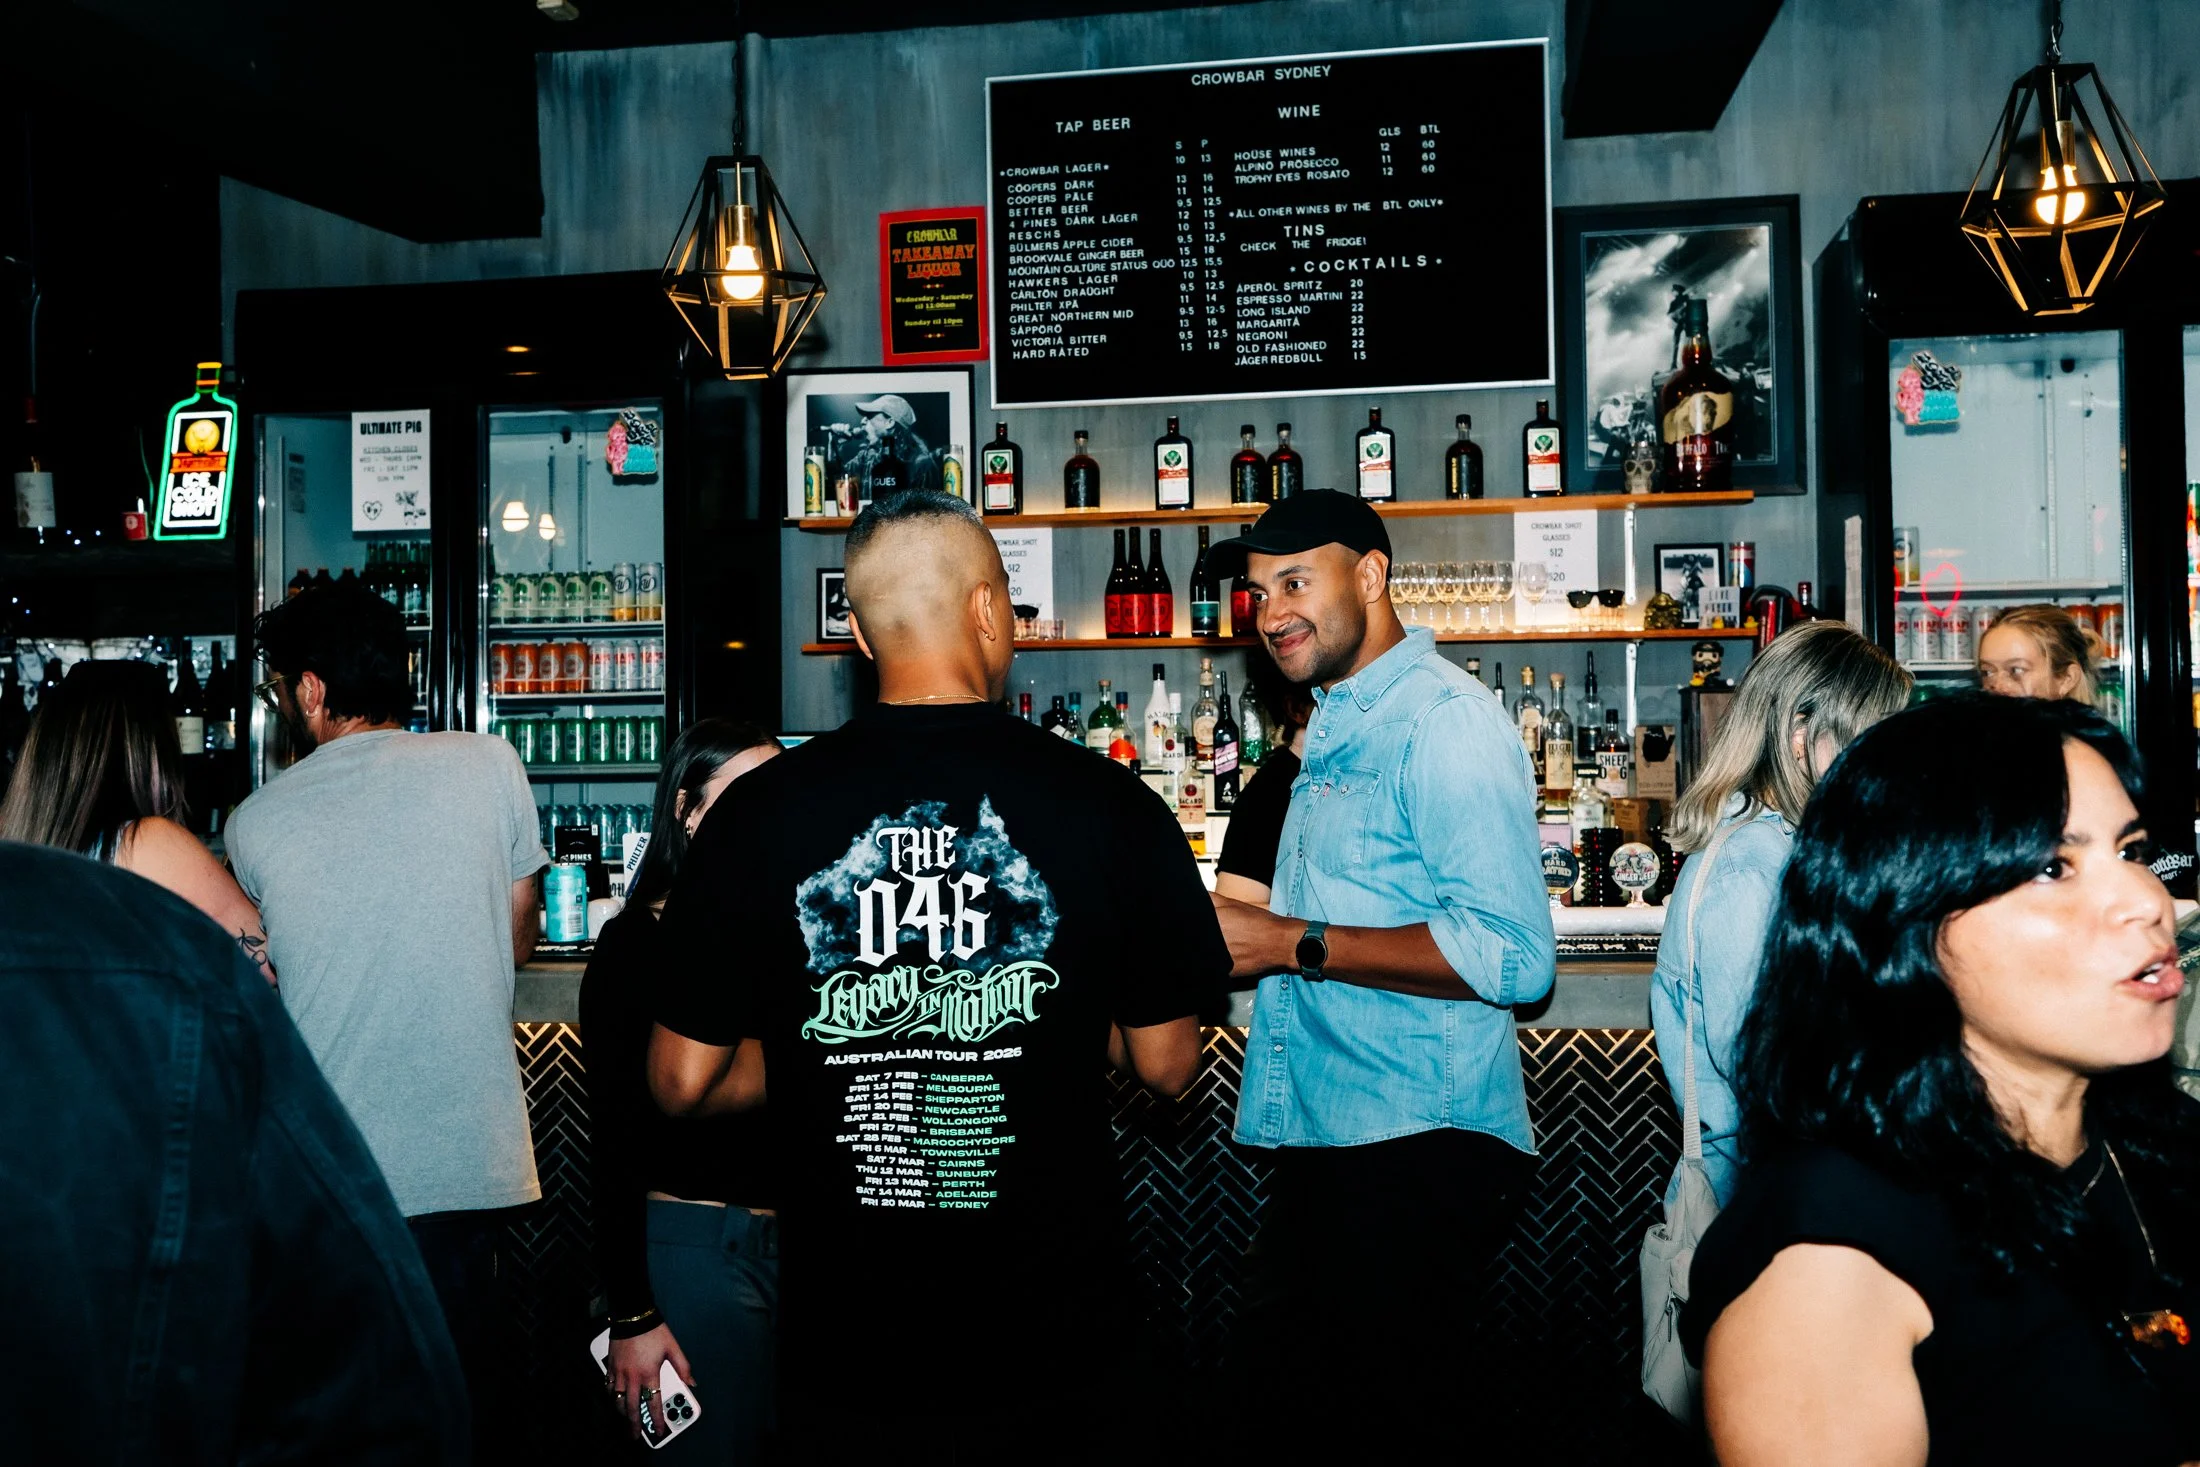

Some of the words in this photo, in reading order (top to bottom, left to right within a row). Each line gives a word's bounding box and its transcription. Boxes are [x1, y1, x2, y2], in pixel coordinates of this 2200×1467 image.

[1191, 70, 1264, 85] CROWBAR
[1275, 65, 1331, 80] SYDNEY
[1278, 105, 1320, 118] WINE
[1056, 121, 1083, 133] TAP
[1093, 118, 1130, 131] BEER
[1379, 127, 1401, 136] GLS
[1420, 124, 1440, 134] BTL
[1279, 147, 1316, 157] WINES
[1006, 165, 1059, 177] CROWBAR
[1066, 163, 1101, 173] LAGER
[1235, 174, 1272, 184] TROPHY
[1276, 172, 1300, 182] EYES
[1307, 169, 1350, 180] ROSATO
[1421, 164, 1435, 173] 60
[1009, 206, 1052, 217] BETTER
[1061, 204, 1088, 214] BEER
[1258, 207, 1292, 217] OTHER
[1296, 205, 1330, 214] WINES
[1335, 204, 1347, 213] BY
[1353, 202, 1371, 211] THE
[1383, 200, 1402, 210] BTL
[1408, 199, 1436, 208] ONLY
[1023, 218, 1057, 227] PINES
[1009, 230, 1061, 240] RESCHS
[1284, 224, 1324, 237] TINS
[1101, 238, 1133, 248] CIDER
[1240, 242, 1276, 252] CHECK
[1292, 240, 1310, 248] THE
[892, 244, 976, 263] TAKEAWAY
[1010, 253, 1072, 264] BROOKVALE
[1078, 250, 1116, 260] GINGER
[1120, 249, 1144, 259] BEER
[1304, 255, 1427, 273] COCKTAILS
[907, 262, 962, 279] LIQUOR
[1009, 277, 1068, 288] HAWKERS
[1079, 274, 1118, 284] LAGER
[1284, 281, 1322, 291] SPRITZ
[1350, 279, 1363, 288] 20
[895, 296, 934, 304] Wednesday
[941, 293, 974, 301] Saturday
[1237, 294, 1291, 305] ESPRESSO
[1300, 292, 1342, 301] MARTINI
[1351, 291, 1363, 300] 22
[1011, 301, 1052, 312] PHILTER
[1237, 308, 1265, 317] LONG
[1271, 305, 1310, 315] ISLAND
[1009, 314, 1043, 324] GREAT
[1113, 310, 1134, 318] MID
[1070, 335, 1106, 344] BITTER
[1237, 331, 1288, 341] NEGRONI
[1236, 344, 1260, 353] OLD
[1265, 341, 1327, 352] FASHIONED
[1352, 339, 1364, 348] 22
[1013, 349, 1045, 359] HARD
[360, 421, 402, 436] ULTIMATE
[405, 420, 422, 433] PIG
[182, 471, 212, 489] ICE
[1009, 587, 1022, 596] 20
[1599, 754, 1627, 766] SHEEP
[626, 836, 648, 871] PHILTER
[876, 825, 959, 875] THE
[853, 871, 991, 967] 046
[824, 1049, 933, 1065] AUSTRALIAN
[935, 1050, 978, 1061] TOUR
[983, 1046, 1022, 1061] 2026
[855, 1074, 880, 1082] SAT
[884, 1072, 892, 1080] 7
[895, 1071, 919, 1079] FEB
[930, 1073, 994, 1082] CANBERRA
[849, 1084, 870, 1093] FRI
[892, 1082, 915, 1090] FEB
[926, 1083, 1000, 1093] MELBOURNE
[845, 1094, 870, 1103] SAT
[873, 1092, 889, 1100] 14
[892, 1092, 913, 1101] FEB
[925, 1094, 1005, 1104] SHEPPARTON
[850, 1103, 871, 1112] FRI
[874, 1102, 891, 1110] 20
[893, 1103, 913, 1111] FEB
[925, 1105, 1000, 1115] NEWCASTLE
[844, 1113, 868, 1122] SAT
[889, 1113, 909, 1122] FEB
[922, 1115, 1007, 1125] WOLLONGONG
[859, 1123, 879, 1131] FRI
[882, 1123, 895, 1131] 27
[897, 1124, 917, 1134] FEB
[930, 1127, 992, 1136] BRISBANE
[836, 1134, 860, 1143] SAT
[881, 1134, 901, 1143] FEB
[913, 1135, 1015, 1146] MAROOCHYDORE
[852, 1144, 872, 1152] FRI
[884, 1145, 907, 1154] MAR
[920, 1148, 1000, 1157] TOWNSVILLE
[866, 1155, 887, 1163] SAT
[889, 1156, 896, 1164] 7
[898, 1157, 925, 1166] MAR
[856, 1165, 878, 1174] THU
[880, 1167, 893, 1175] 12
[896, 1168, 923, 1176] MAR
[865, 1176, 882, 1185] FRI
[902, 1178, 929, 1187] MAR
[856, 1186, 876, 1195] SAT
[879, 1188, 893, 1196] 14
[895, 1188, 922, 1197] MAR
[861, 1197, 878, 1206] FRI
[881, 1198, 896, 1207] 20
[898, 1199, 925, 1208] MAR
[939, 1201, 989, 1209] SYDNEY
